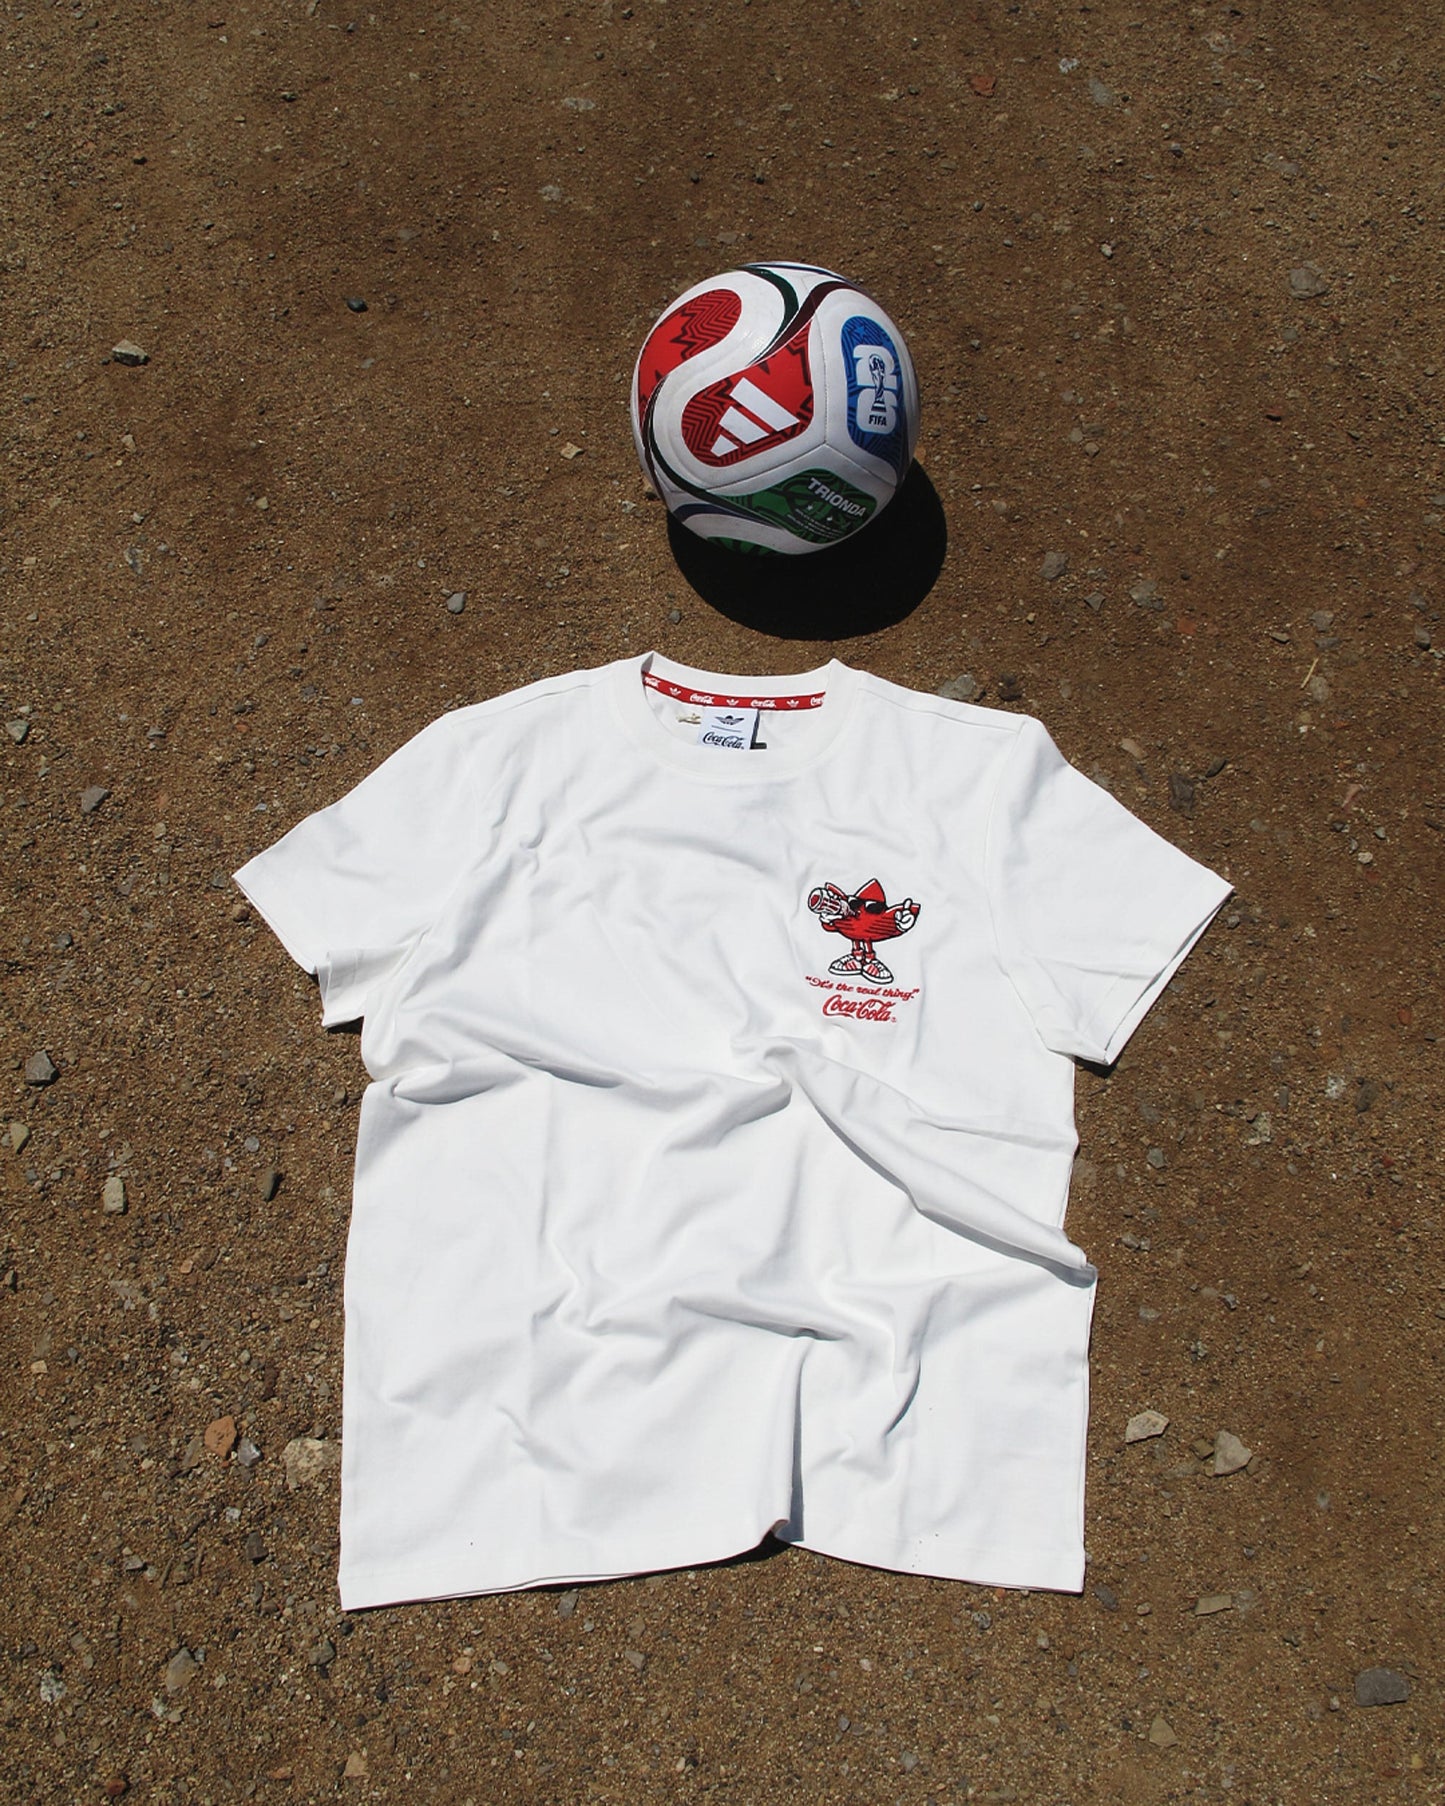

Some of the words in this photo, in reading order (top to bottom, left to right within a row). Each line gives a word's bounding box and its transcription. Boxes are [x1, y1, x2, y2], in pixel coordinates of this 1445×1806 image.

[868, 414, 888, 427] FIFA
[807, 477, 867, 517] TRIONDA
[835, 983, 854, 992] the
[856, 986, 881, 996] real
